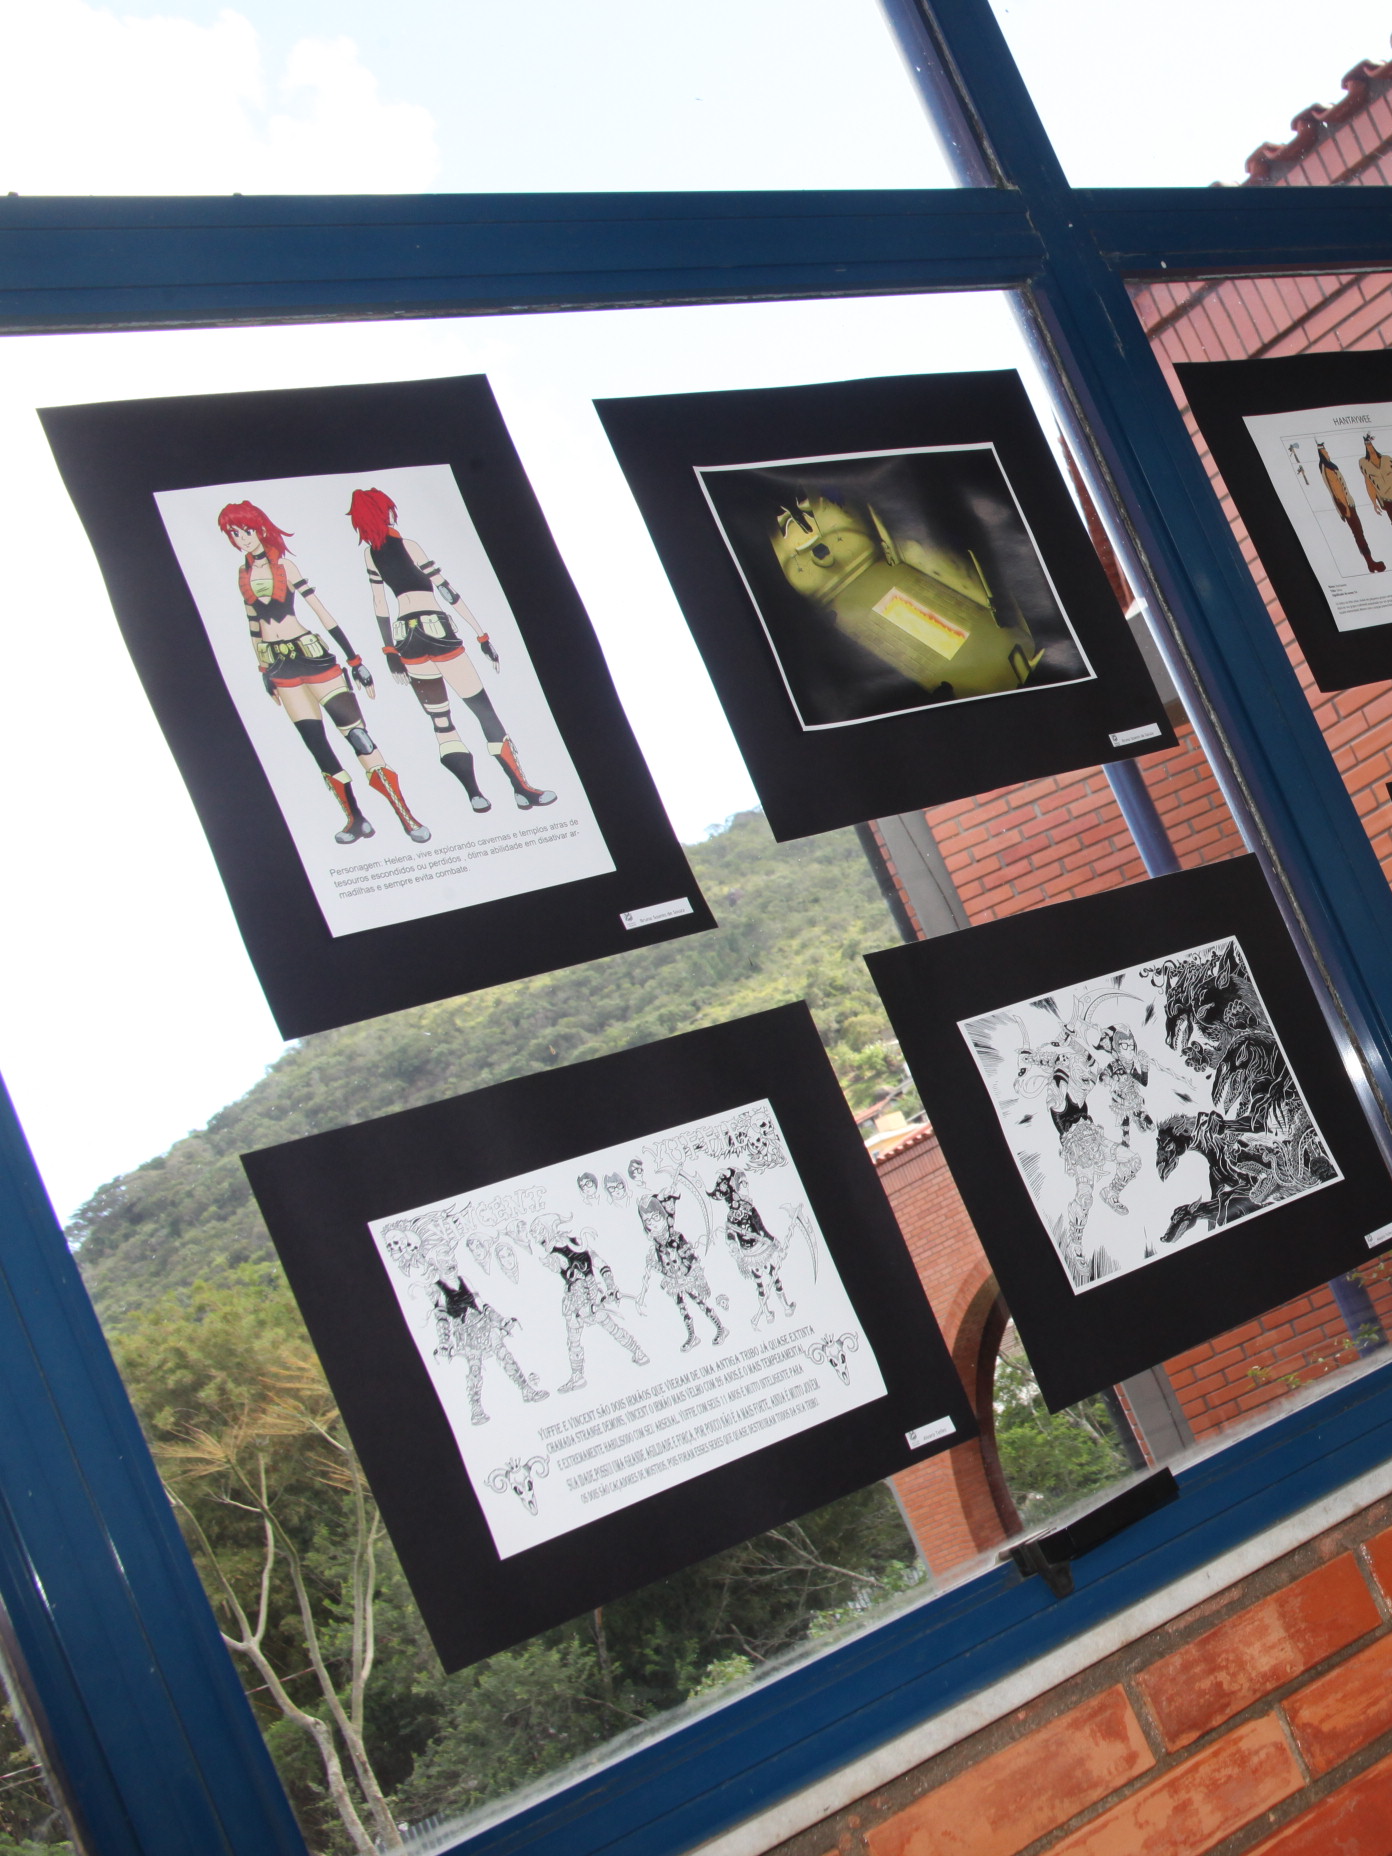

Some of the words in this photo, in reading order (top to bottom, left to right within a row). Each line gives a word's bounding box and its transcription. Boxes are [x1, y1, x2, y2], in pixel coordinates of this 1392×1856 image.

[1333, 414, 1372, 426] HANTAYWEE
[330, 859, 384, 878] Personagem:
[384, 853, 415, 865] Helena,
[416, 849, 431, 858] vive
[433, 840, 476, 855] explorando
[477, 833, 511, 845] cavernas
[519, 825, 548, 837] templos
[334, 874, 369, 887] tesouros
[370, 864, 415, 879] escondidos
[428, 855, 461, 868] perdidos
[467, 849, 488, 859] ótima
[490, 841, 523, 854] abilidade
[538, 832, 568, 843] disativar
[338, 884, 375, 898] madilhas
[384, 878, 414, 890] sempre
[415, 872, 433, 882] evita
[435, 864, 471, 877] combate.
[538, 1422, 562, 1439] YUFFIE
[568, 1409, 597, 1428] VINCENT
[595, 1402, 610, 1417] SÃO
[611, 1399, 625, 1411] DOIS
[625, 1387, 650, 1406] IRMÃOS
[651, 1383, 665, 1396] QUE
[665, 1373, 689, 1390] VIERAM
[700, 1364, 714, 1377] UMA
[716, 1354, 740, 1370] ANTIGA
[741, 1346, 759, 1360] TRIBO
[769, 1334, 789, 1350] QUASE
[790, 1324, 814, 1341] EXTINTA
[546, 1434, 575, 1453] CHAMADA
[626, 1404, 649, 1422] VINCENT
[653, 1394, 672, 1411] IRMÃO
[672, 1391, 685, 1404] MAIS
[686, 1383, 704, 1398] VELHO
[704, 1379, 715, 1391] COM
[749, 1361, 761, 1373] MAIS
[562, 1444, 604, 1468] EXTREMAMENTE
[633, 1427, 644, 1440] COM
[679, 1405, 697, 1421] YUFFIE
[697, 1402, 707, 1414] COM
[728, 1388, 741, 1401] ANOS
[790, 1363, 803, 1376] PARA
[612, 1458, 624, 1472] UMA
[624, 1449, 646, 1467] GRANDE
[695, 1424, 705, 1438] POR
[705, 1417, 722, 1434] POUCO
[720, 1411, 732, 1427] NÃO
[741, 1405, 753, 1419] MAIS
